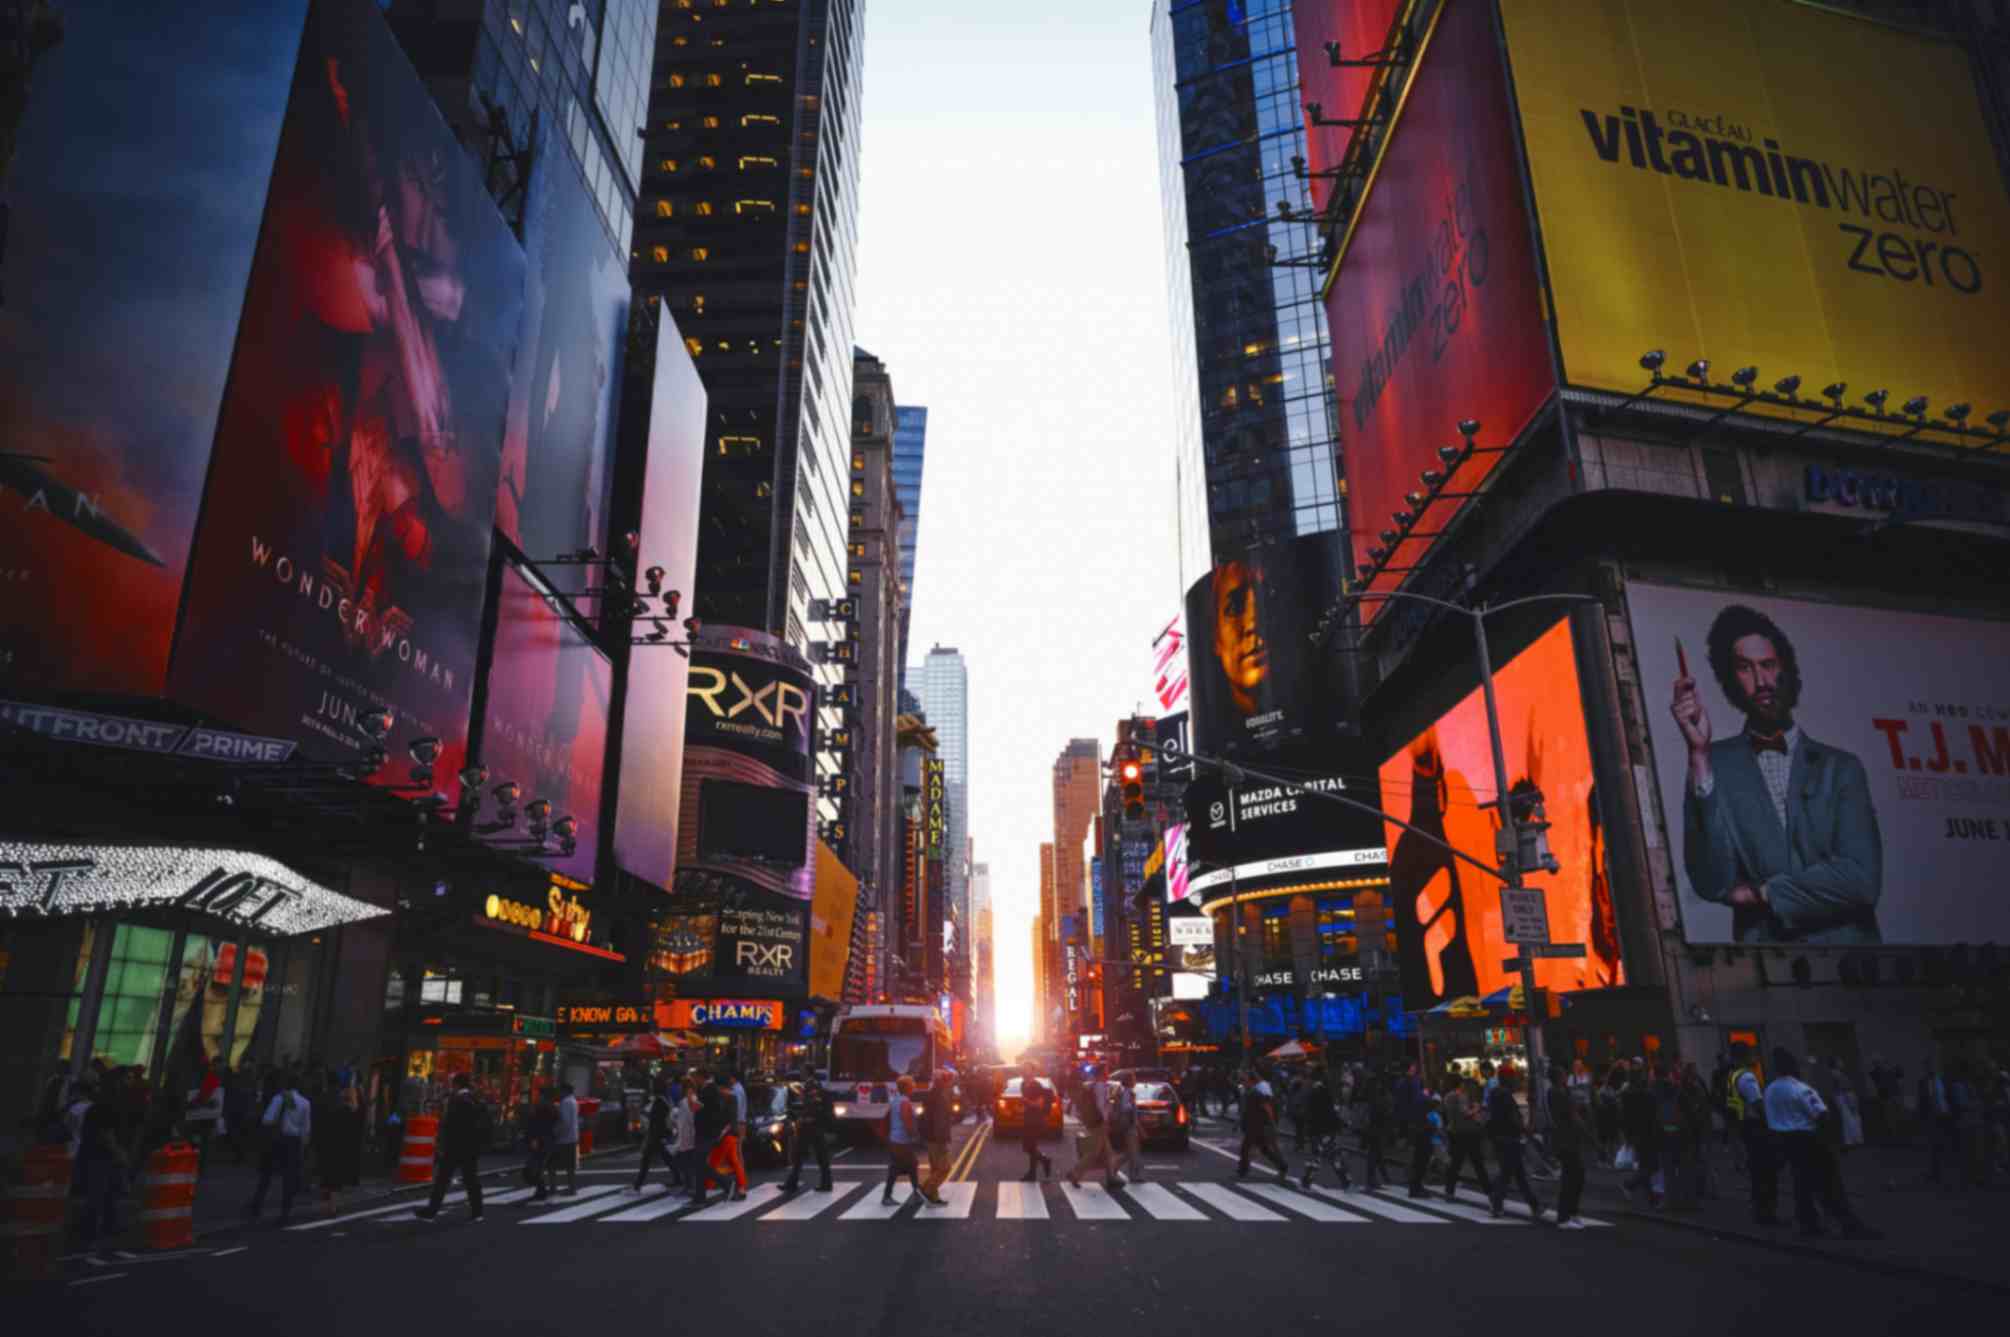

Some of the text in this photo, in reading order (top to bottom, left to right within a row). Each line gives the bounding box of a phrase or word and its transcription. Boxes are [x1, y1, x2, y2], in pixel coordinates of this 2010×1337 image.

[1580, 106, 1959, 237] vitaminwater
[1838, 222, 1981, 294] zero
[1431, 229, 1488, 362] zero
[251, 535, 454, 688] WONDER WOMAN
[688, 666, 804, 737] RXR
[194, 734, 283, 762] PRIME
[1240, 789, 1282, 805] MAZDA
[1240, 801, 1297, 821] SERVICES
[1945, 817, 2000, 842] JUNE
[178, 867, 304, 924] LOFT
[736, 940, 793, 970] RXR
[1066, 944, 1077, 1011] REGAL
[1311, 967, 1363, 983] CHASE
[570, 1008, 609, 1024] KNOW
[691, 1004, 774, 1025] CHAMPS
